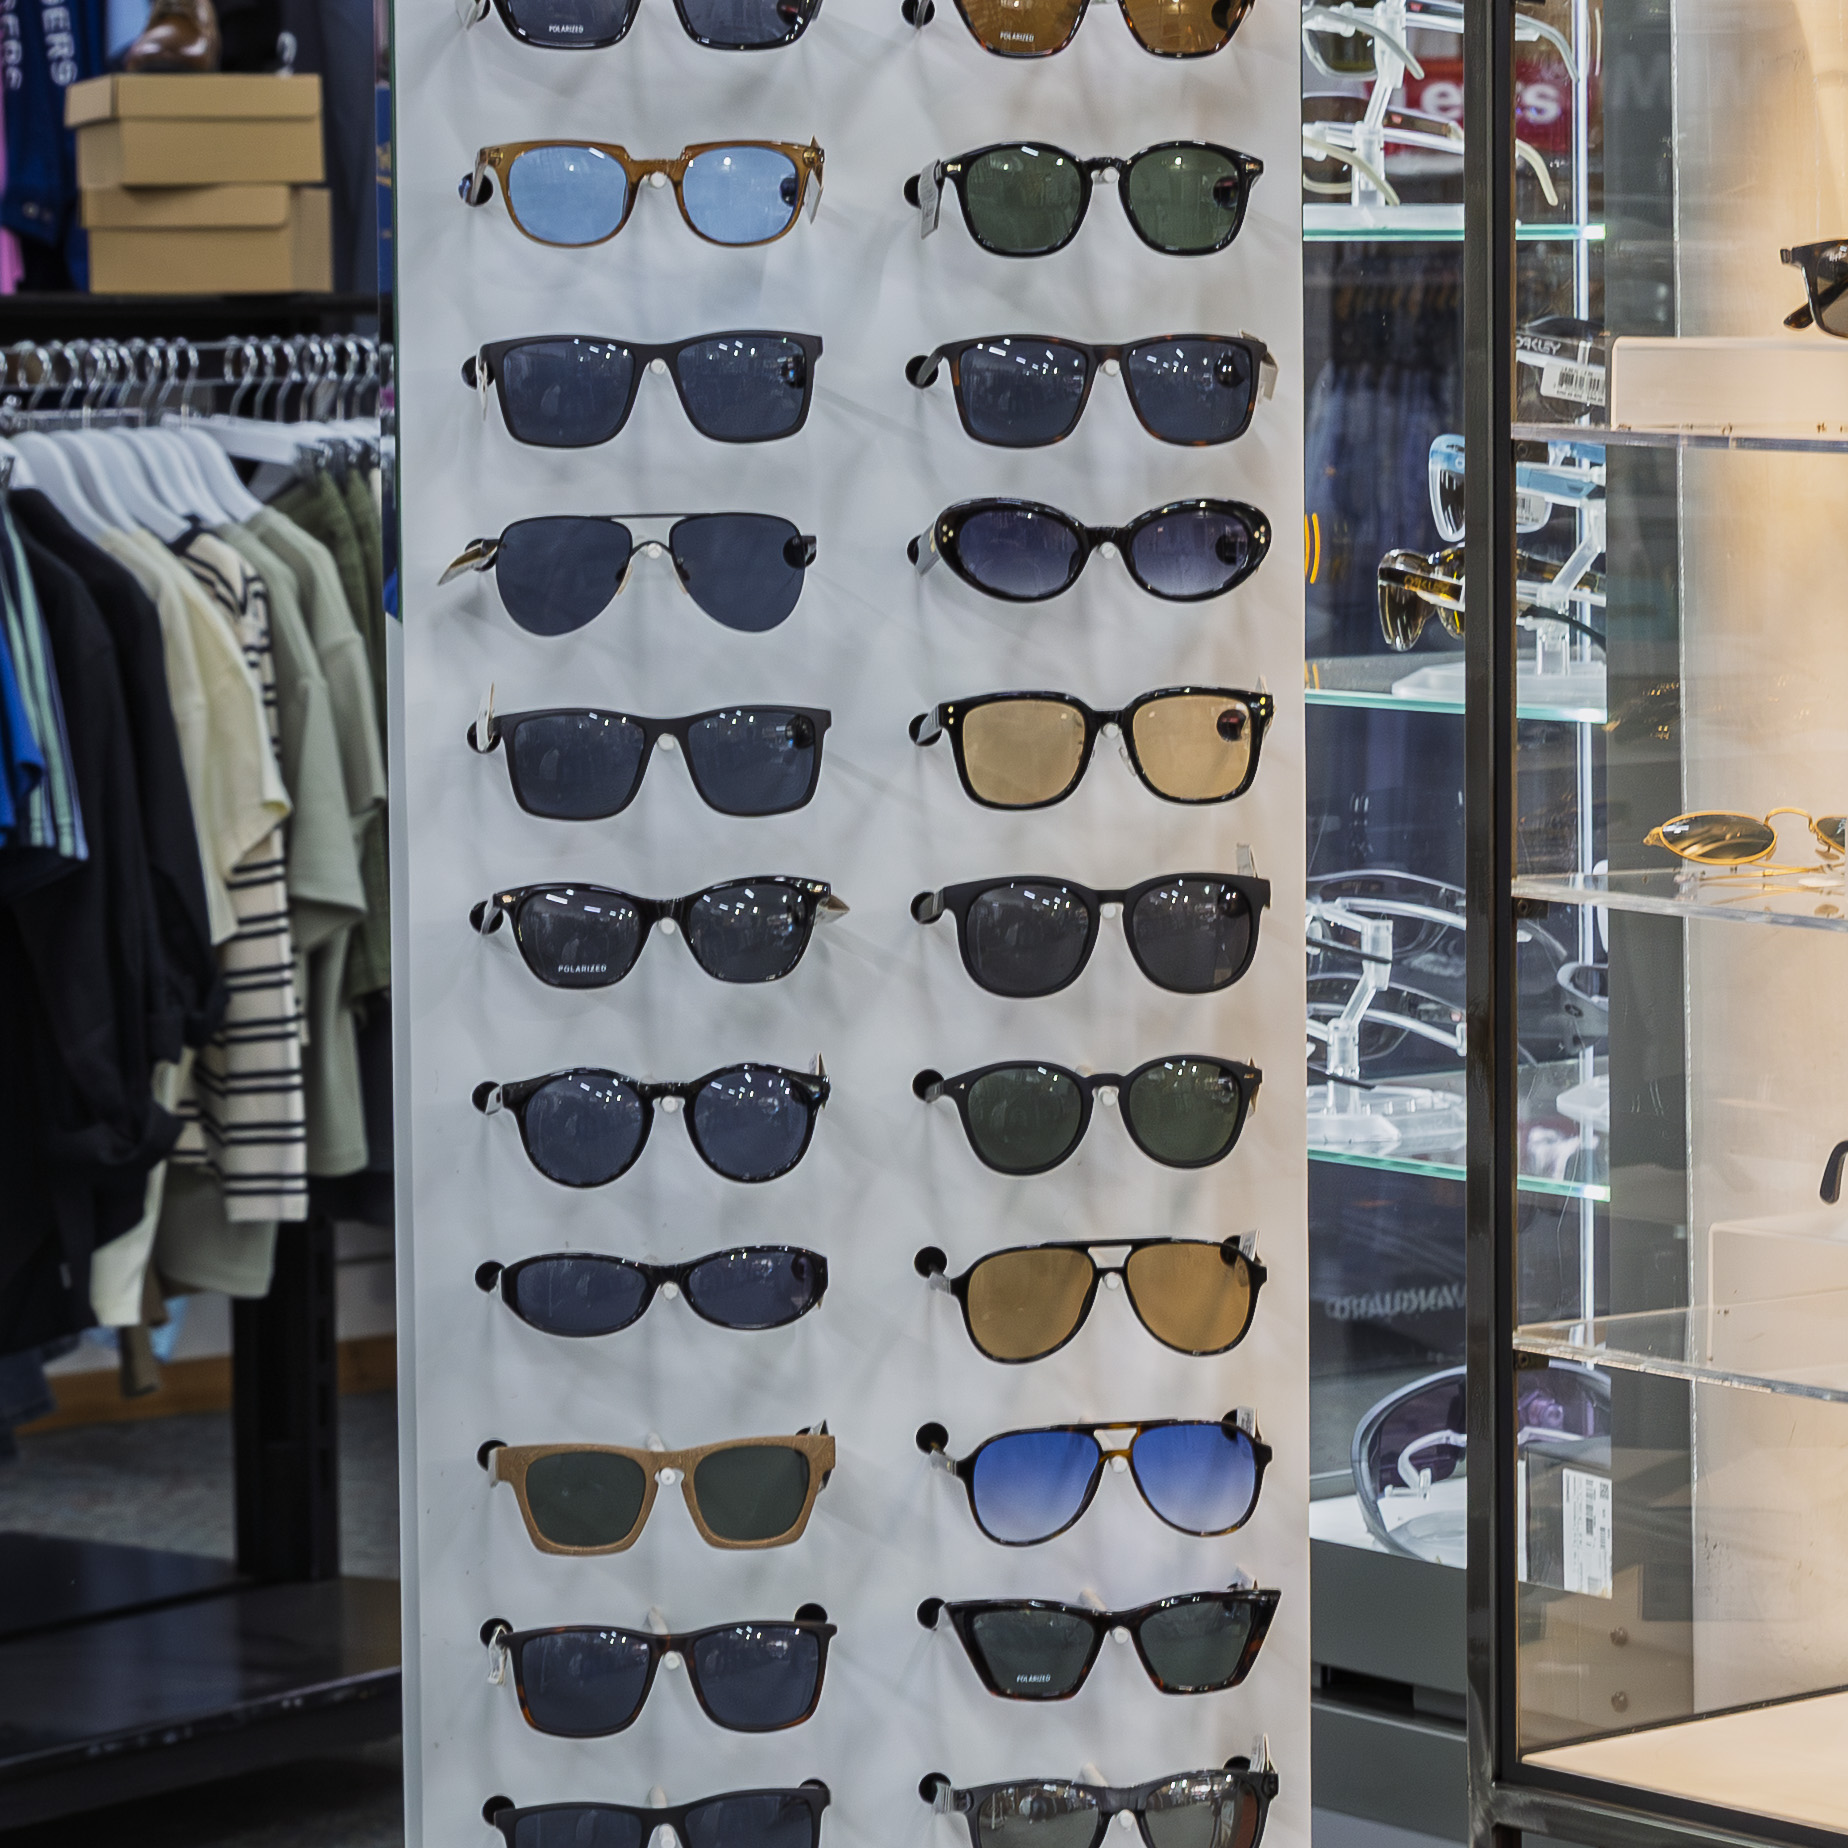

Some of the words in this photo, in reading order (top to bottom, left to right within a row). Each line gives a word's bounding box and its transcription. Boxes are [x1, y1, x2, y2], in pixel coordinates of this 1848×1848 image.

[548, 24, 584, 34] POLARIZED
[1000, 31, 1035, 43] POLARIZED
[558, 963, 607, 973] POLARIZED
